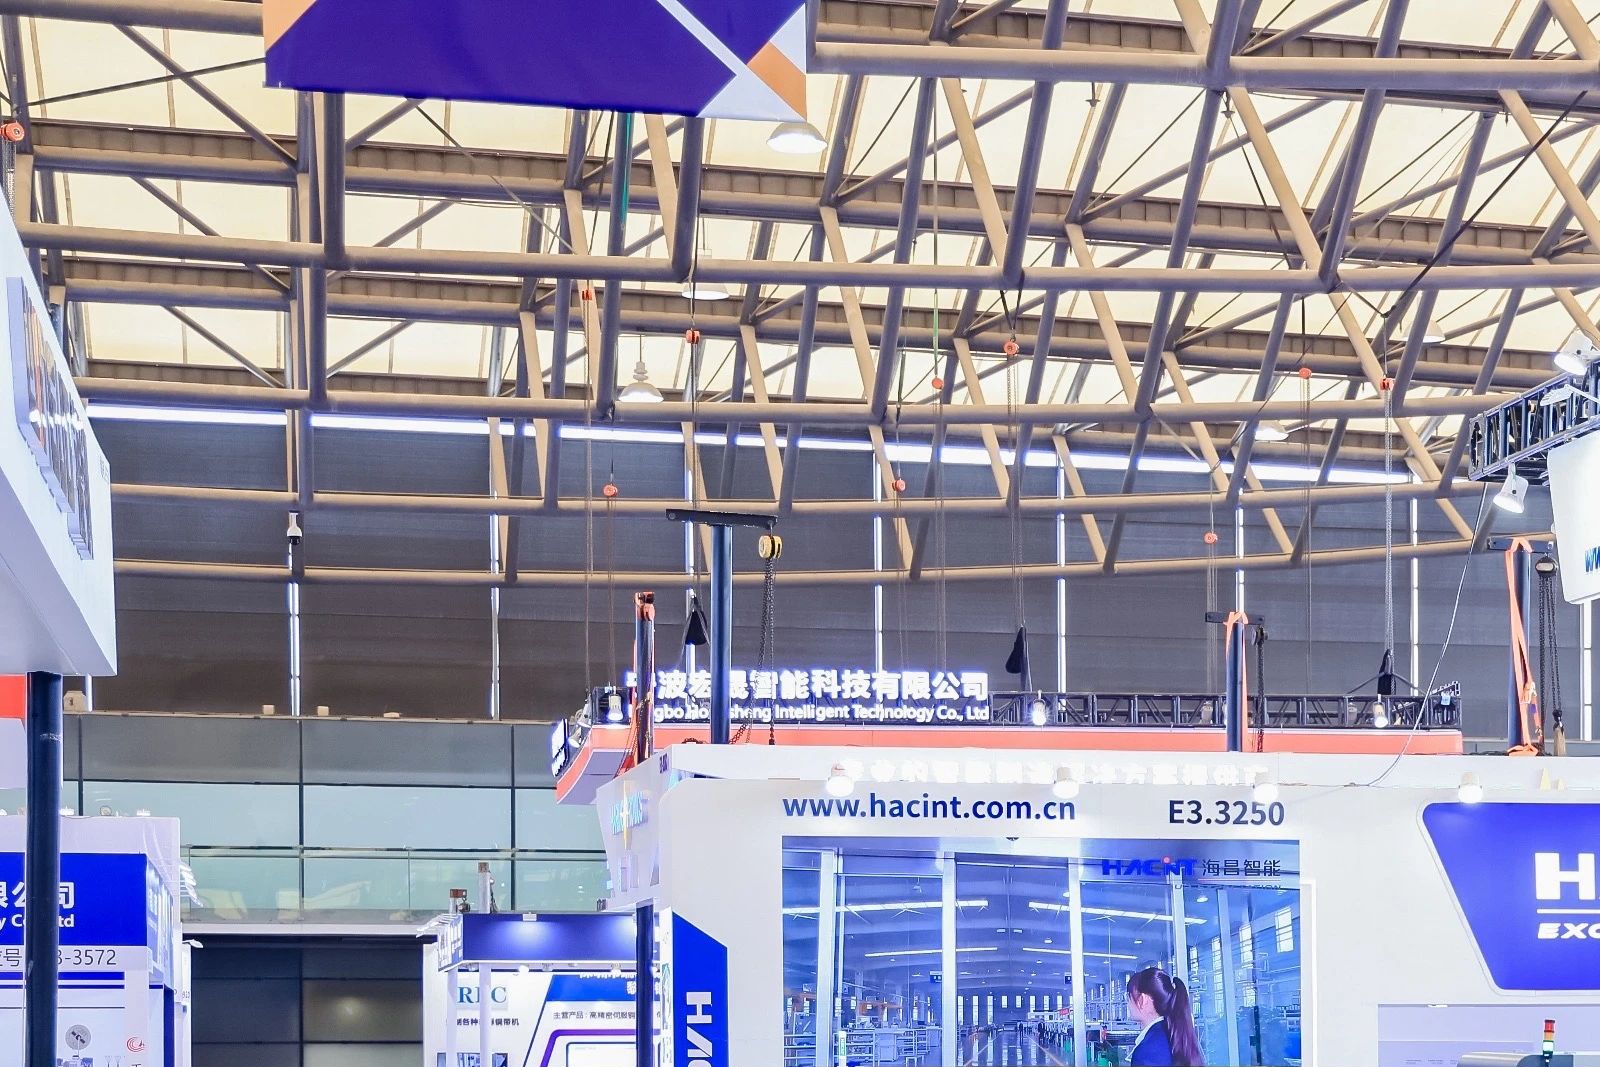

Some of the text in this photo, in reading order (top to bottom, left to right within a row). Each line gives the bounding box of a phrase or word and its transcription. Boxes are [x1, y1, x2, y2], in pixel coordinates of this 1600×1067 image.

[775, 703, 851, 721] Intelligent
[853, 703, 934, 723] Technology
[936, 705, 963, 722] Co.,
[966, 705, 990, 721] Ltd
[783, 793, 1286, 827] www.hacint.com.cn E3.3250
[1202, 858, 1281, 877] 海昌智能
